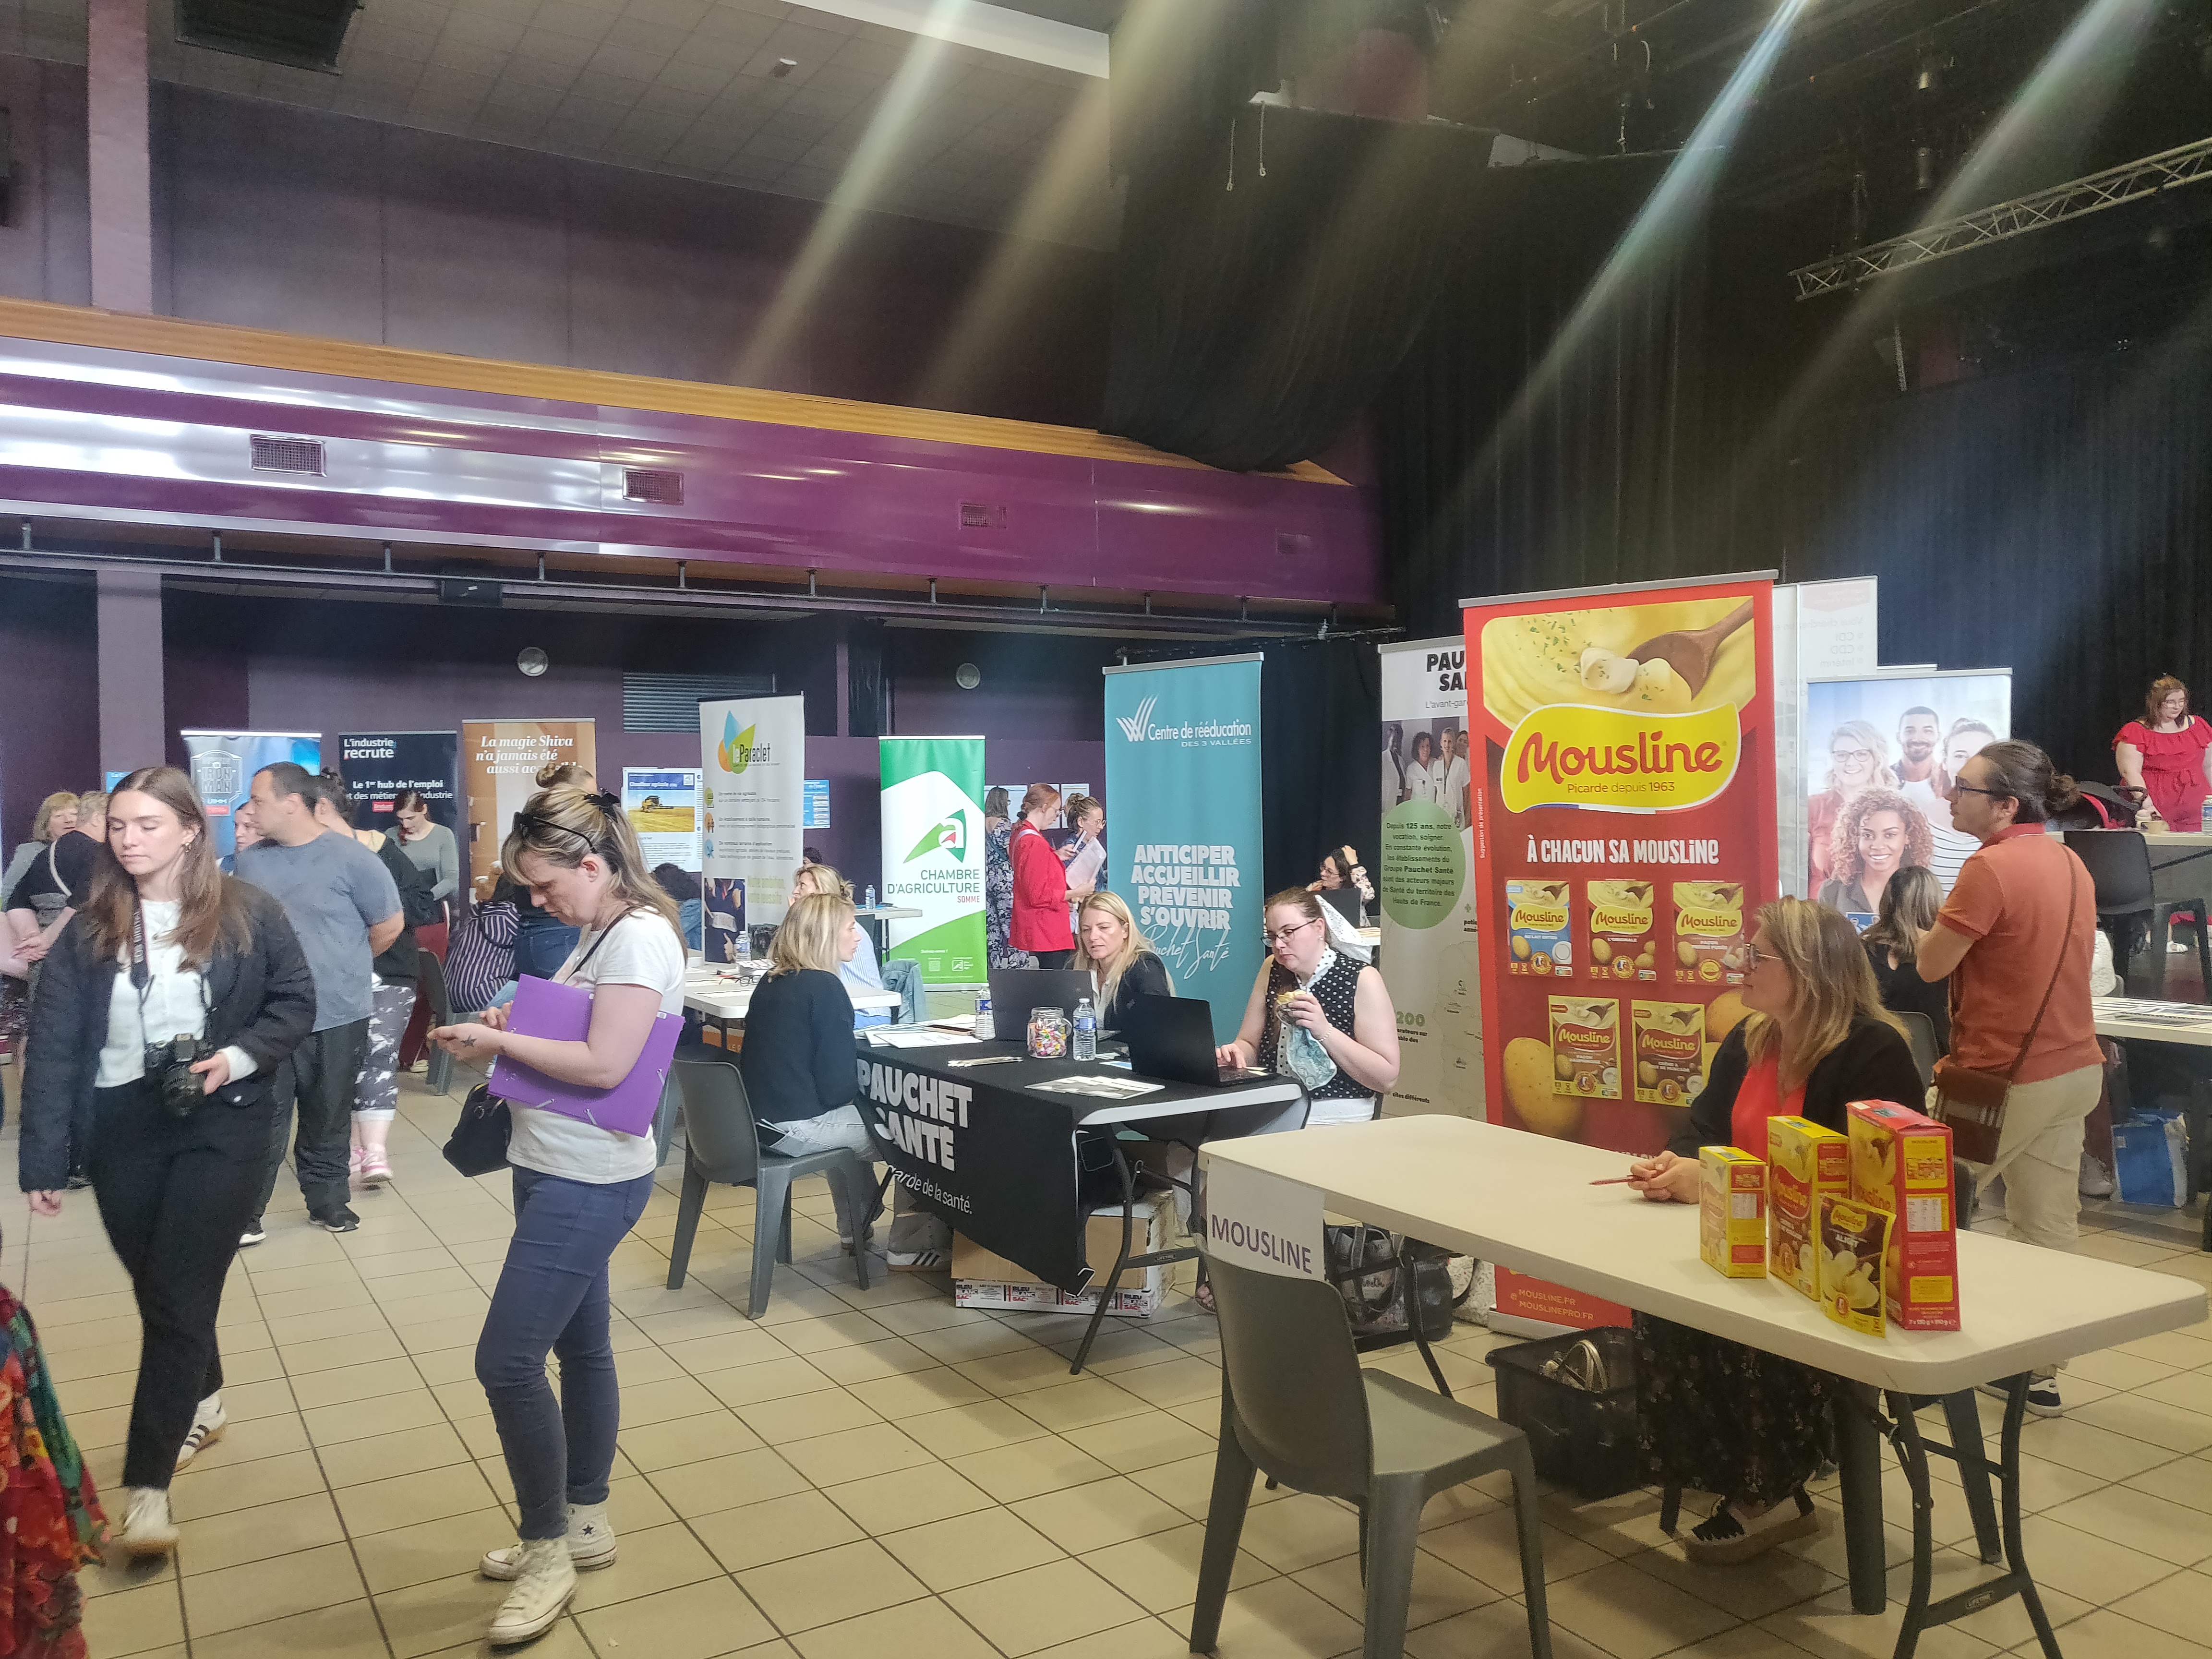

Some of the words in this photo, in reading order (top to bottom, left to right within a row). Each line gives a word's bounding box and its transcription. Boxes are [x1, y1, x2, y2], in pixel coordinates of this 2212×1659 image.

[1426, 650, 1465, 672] PAU
[1148, 723, 1179, 741] Centre
[1181, 721, 1193, 739] de
[1195, 719, 1251, 738] rééducation
[344, 738, 394, 747] L'industrie
[481, 735, 496, 747] La
[497, 735, 537, 750] magie
[539, 735, 574, 747] Shiva
[344, 748, 394, 758] recrute
[476, 750, 493, 761] n'a
[493, 749, 538, 764] jamais
[540, 749, 558, 760] été
[1517, 730, 1723, 784] Mousline
[486, 763, 519, 774] aussi
[202, 780, 232, 794] MAN
[377, 780, 395, 788] hub
[396, 780, 408, 788] de
[408, 780, 444, 790] l'emploi
[1567, 783, 1609, 793] Picarde
[1611, 782, 1647, 794] depuis
[1648, 781, 1675, 792] 1963
[1134, 844, 1237, 865] ANTICIPER
[1527, 834, 1538, 863] À
[1541, 839, 1605, 863] CHACUN
[1609, 839, 1629, 863] SA
[920, 869, 980, 880] CHAMBRE
[1130, 865, 1241, 887] ACCUEILLIR
[888, 882, 980, 894] D'AGRICULTURE
[1140, 906, 1232, 930] S'OUVRIR
[1515, 910, 1564, 923] Mousline
[1595, 912, 1648, 926] Mousline
[1681, 914, 1738, 928] Mousline
[1559, 1028, 1611, 1044] Mousline
[1642, 1034, 1696, 1051] Mousline
[856, 1058, 973, 1129] PAUCHET
[922, 1178, 934, 1197] de
[934, 1182, 942, 1202] la
[942, 1191, 973, 1214] santé.
[1211, 1214, 1312, 1275] MOUSLINE
[1518, 1288, 1576, 1306] MOUSLINE.FR
[1519, 1300, 1594, 1321] MOUSLINEPRO.FR
